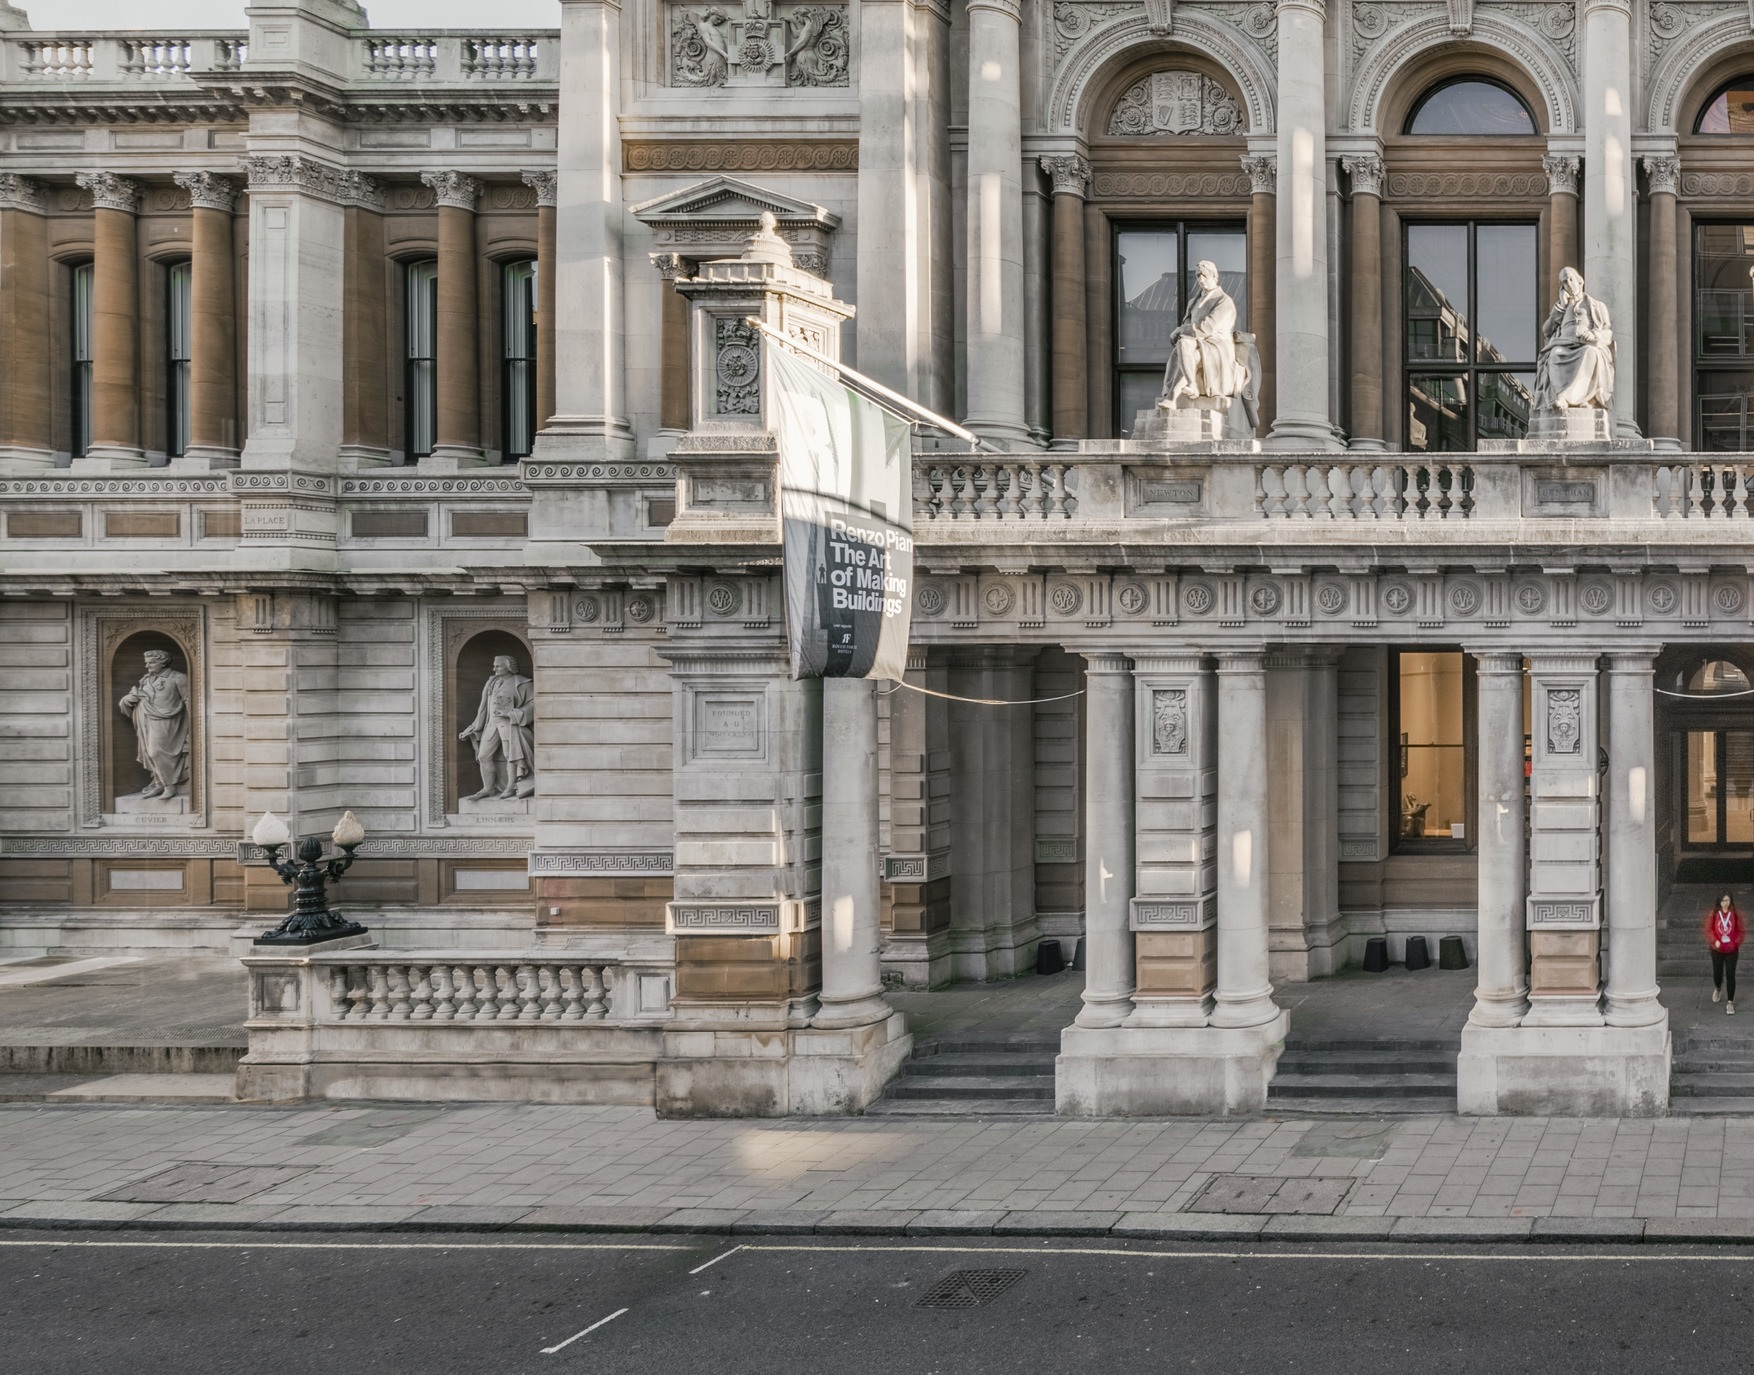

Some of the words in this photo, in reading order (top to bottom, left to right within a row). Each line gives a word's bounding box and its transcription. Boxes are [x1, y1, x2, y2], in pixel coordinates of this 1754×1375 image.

[1150, 489, 1193, 497] NEWTON
[1542, 489, 1591, 497] BENTHAM
[257, 517, 285, 525] PLACE
[830, 518, 885, 547] Renzo
[829, 541, 866, 566] The
[868, 547, 892, 570] Art
[830, 566, 853, 586] of
[856, 567, 907, 598] Making
[833, 587, 902, 618] Buildings
